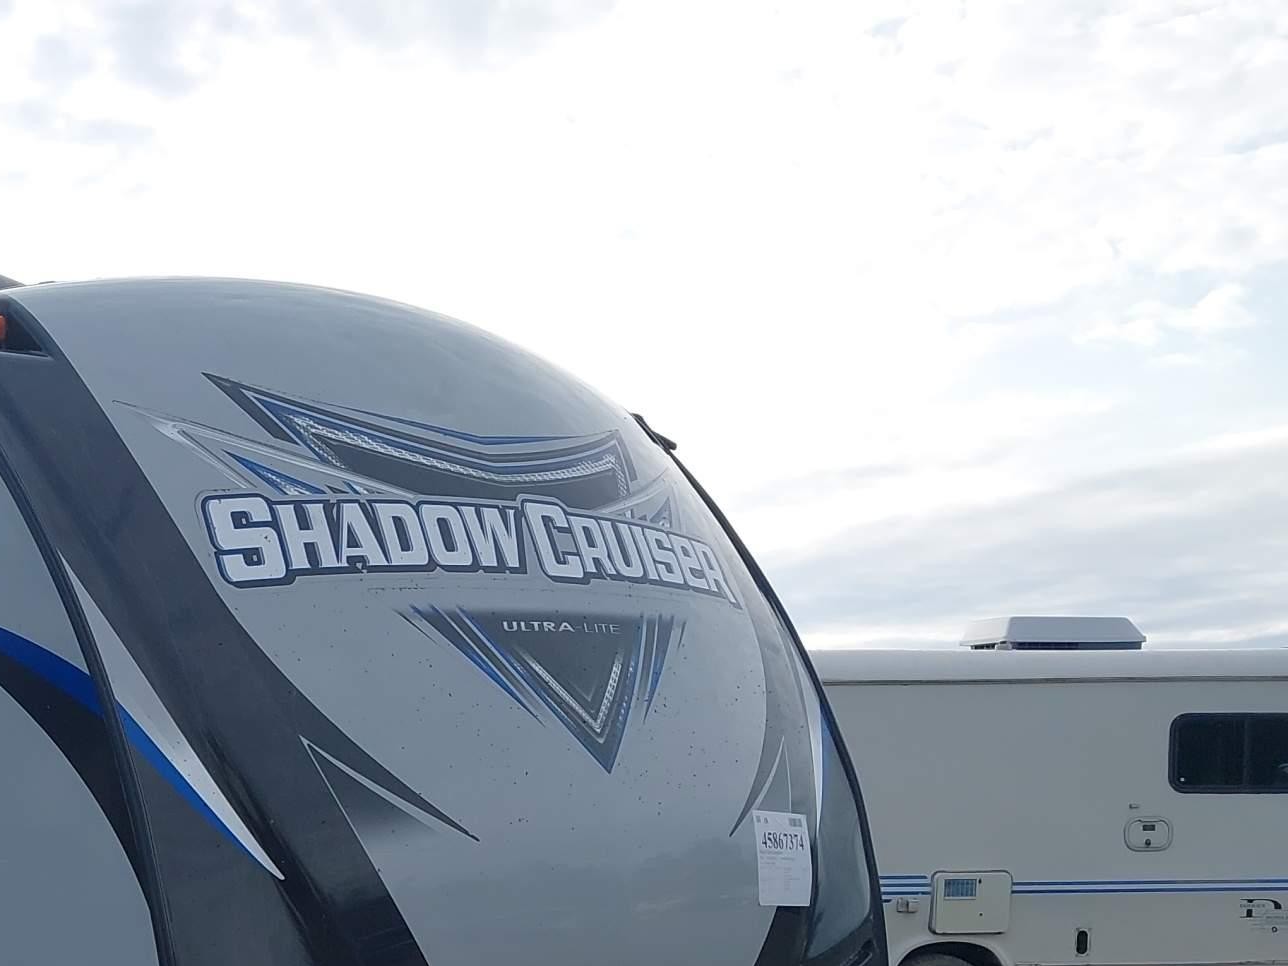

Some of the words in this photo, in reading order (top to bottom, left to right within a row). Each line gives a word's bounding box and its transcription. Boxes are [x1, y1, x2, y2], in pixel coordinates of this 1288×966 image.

[208, 496, 524, 584] SHADOW
[522, 497, 739, 605] CRUISER
[761, 831, 805, 851] 45867374
